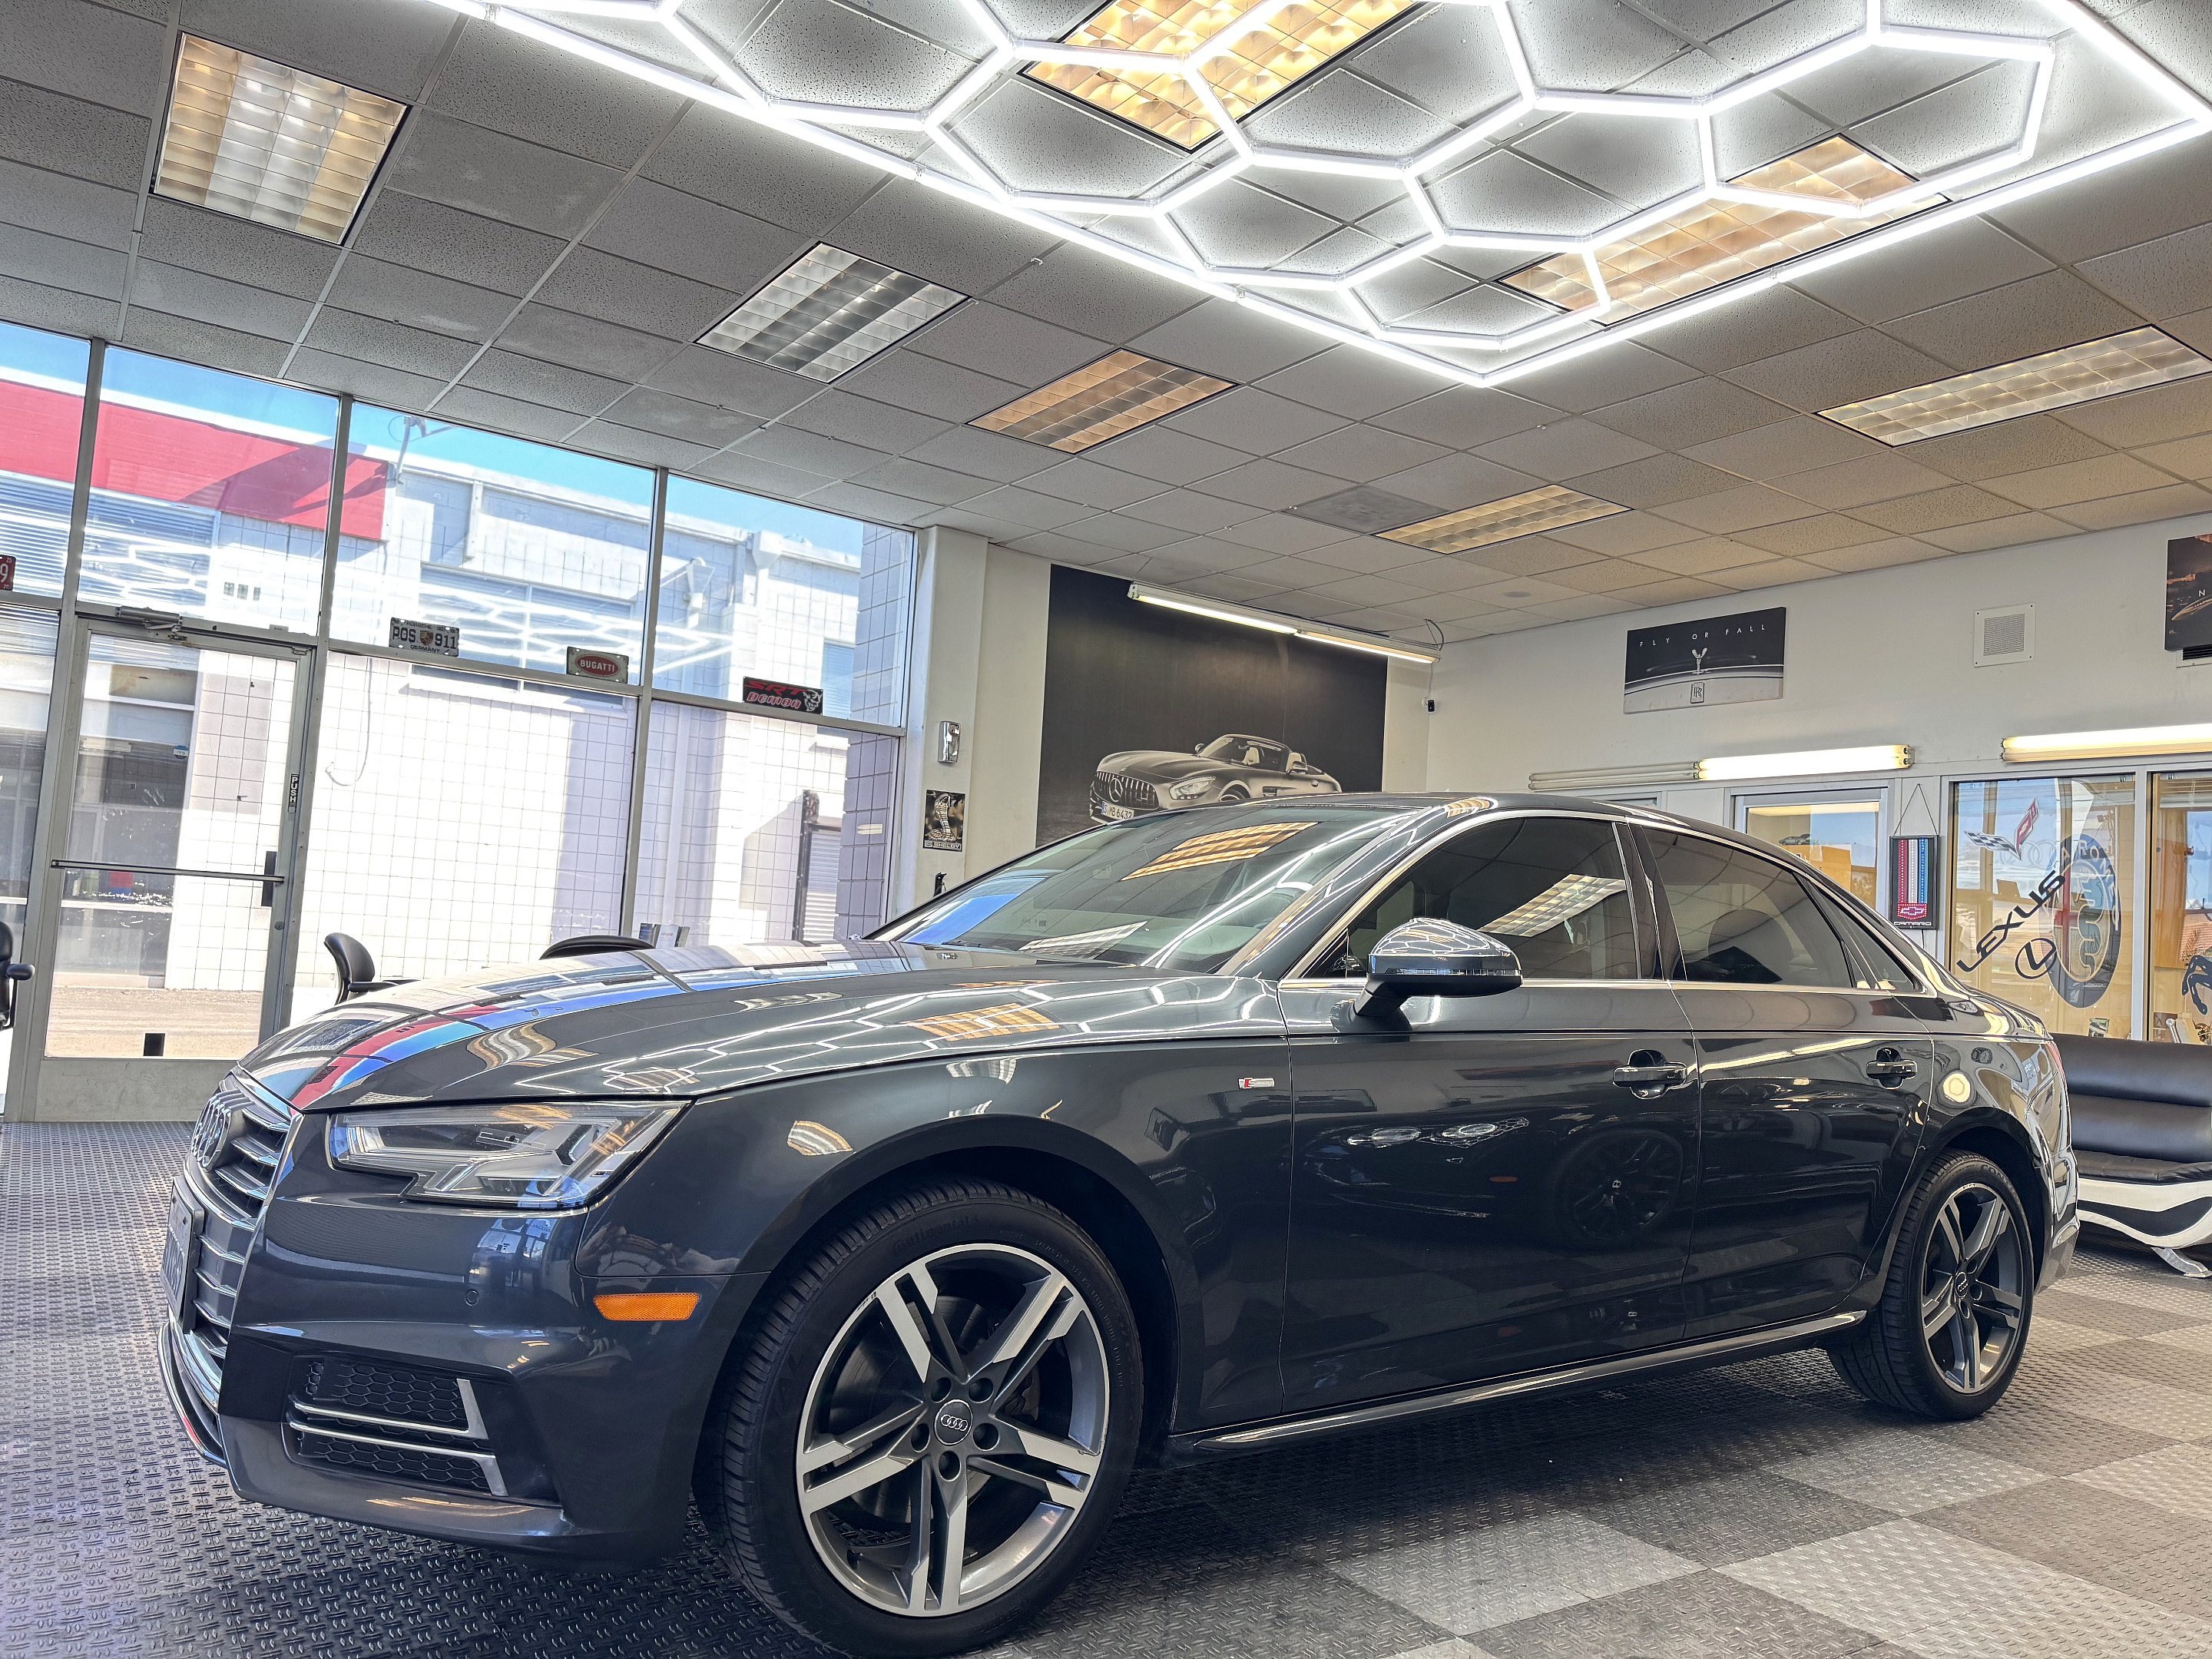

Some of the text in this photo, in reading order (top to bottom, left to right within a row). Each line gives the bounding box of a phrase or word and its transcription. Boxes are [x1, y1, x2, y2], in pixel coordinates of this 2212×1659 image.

[406, 621, 432, 629] PORSCHE
[392, 626, 456, 650] POS 911
[1640, 637, 1670, 647] FLY
[1726, 624, 1765, 635] FALL
[409, 644, 441, 653] GERMANY
[580, 660, 614, 672] BUGATTI
[745, 680, 808, 696] SRT
[290, 777, 299, 803] PUSH
[1956, 870, 2066, 973] LEXUS
